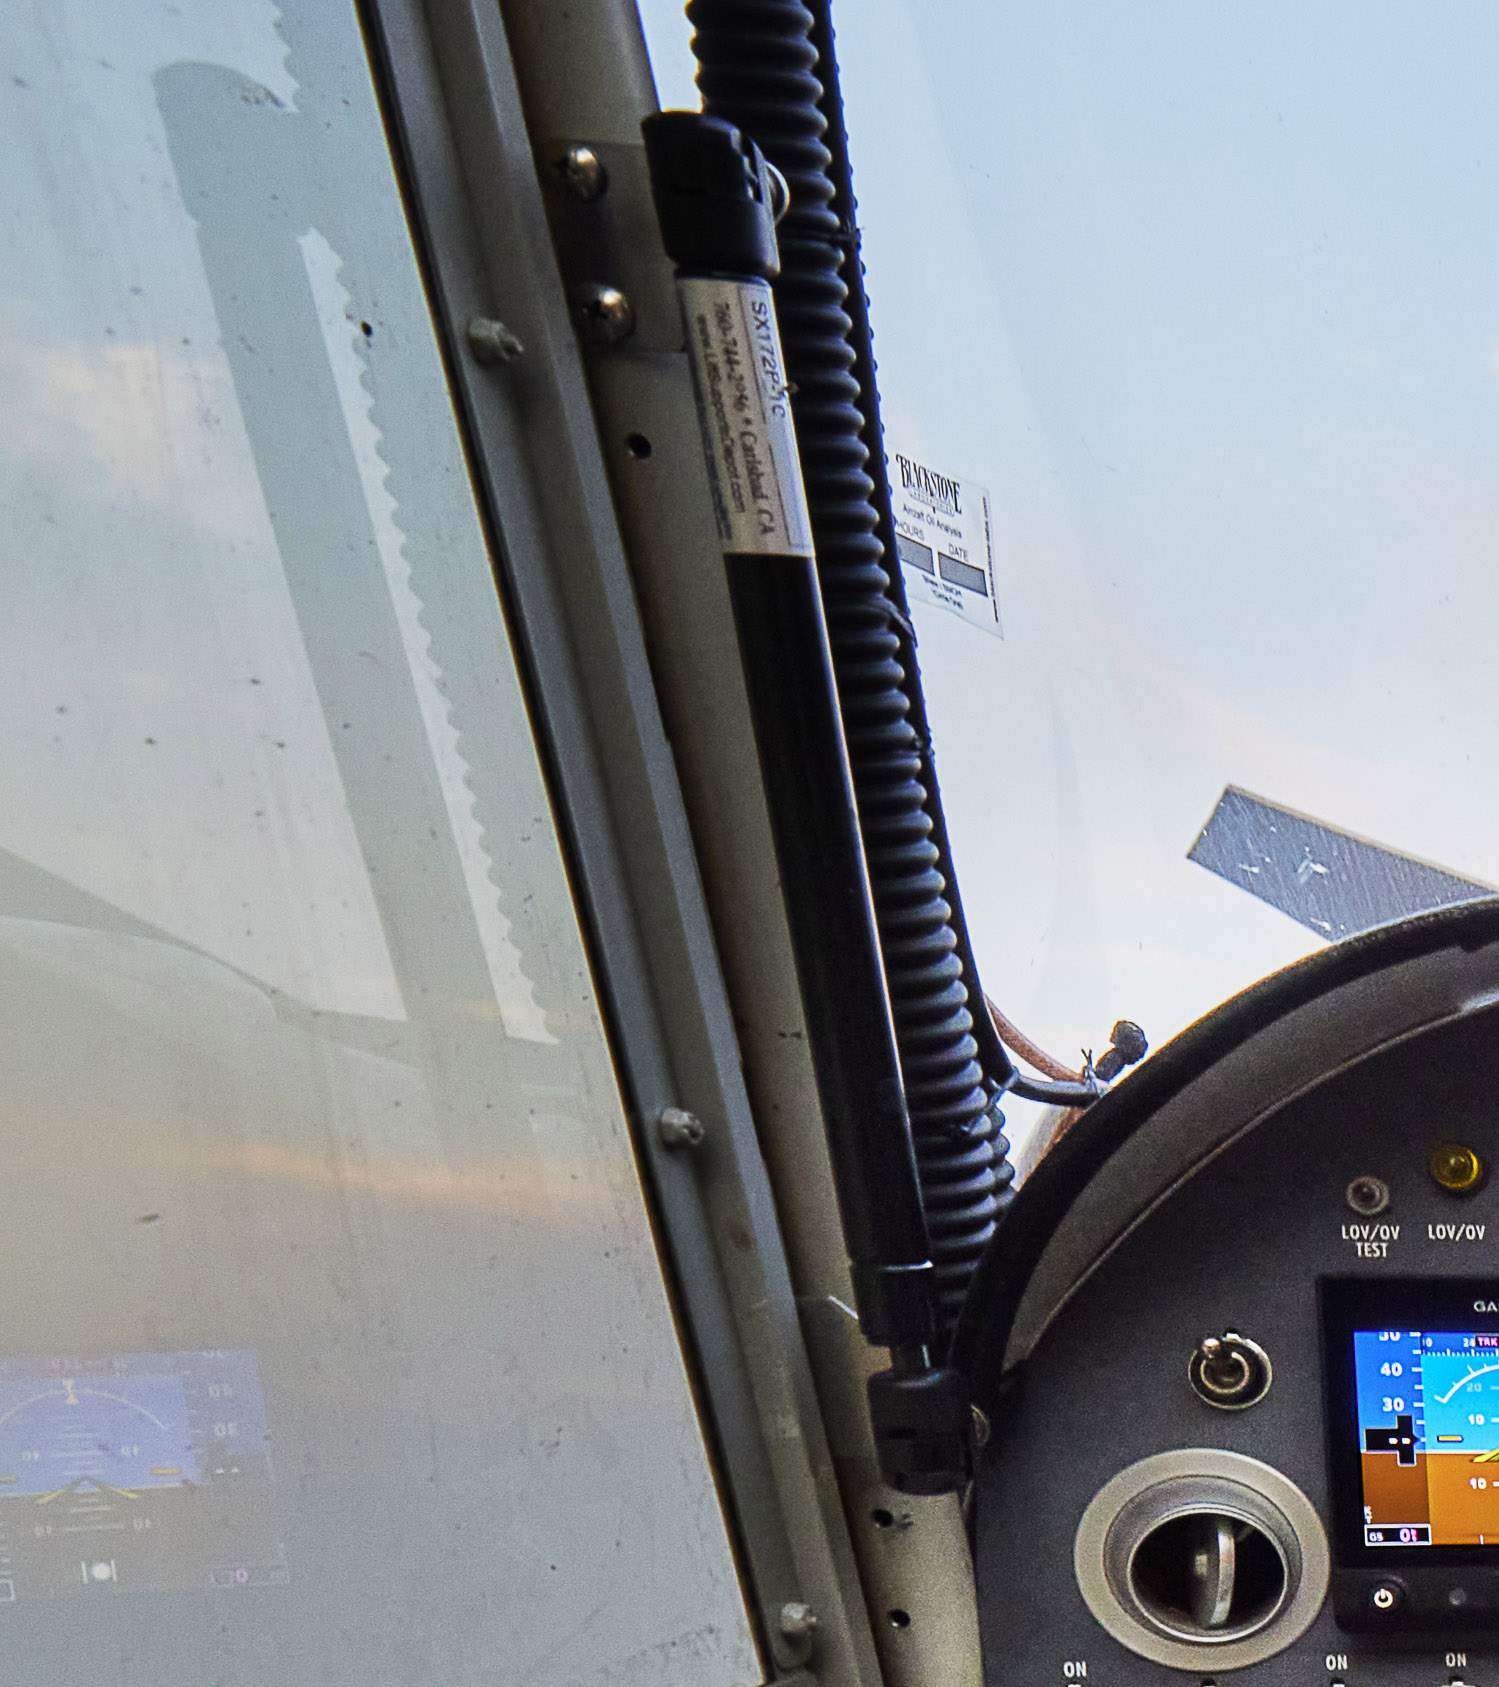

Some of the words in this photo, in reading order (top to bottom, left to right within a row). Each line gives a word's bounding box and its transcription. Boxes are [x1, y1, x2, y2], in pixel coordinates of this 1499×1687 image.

[896, 454, 961, 514] BLACKSTONE
[949, 544, 968, 562] DATE
[1356, 1243, 1388, 1257] TEST
[1381, 1363, 1402, 1375] 40
[1382, 1399, 1404, 1411] 30
[1470, 1478, 1486, 1489] 10
[1326, 1655, 1347, 1670] ON
[1446, 1653, 1466, 1667] ON
[1063, 1662, 1086, 1677] ON
